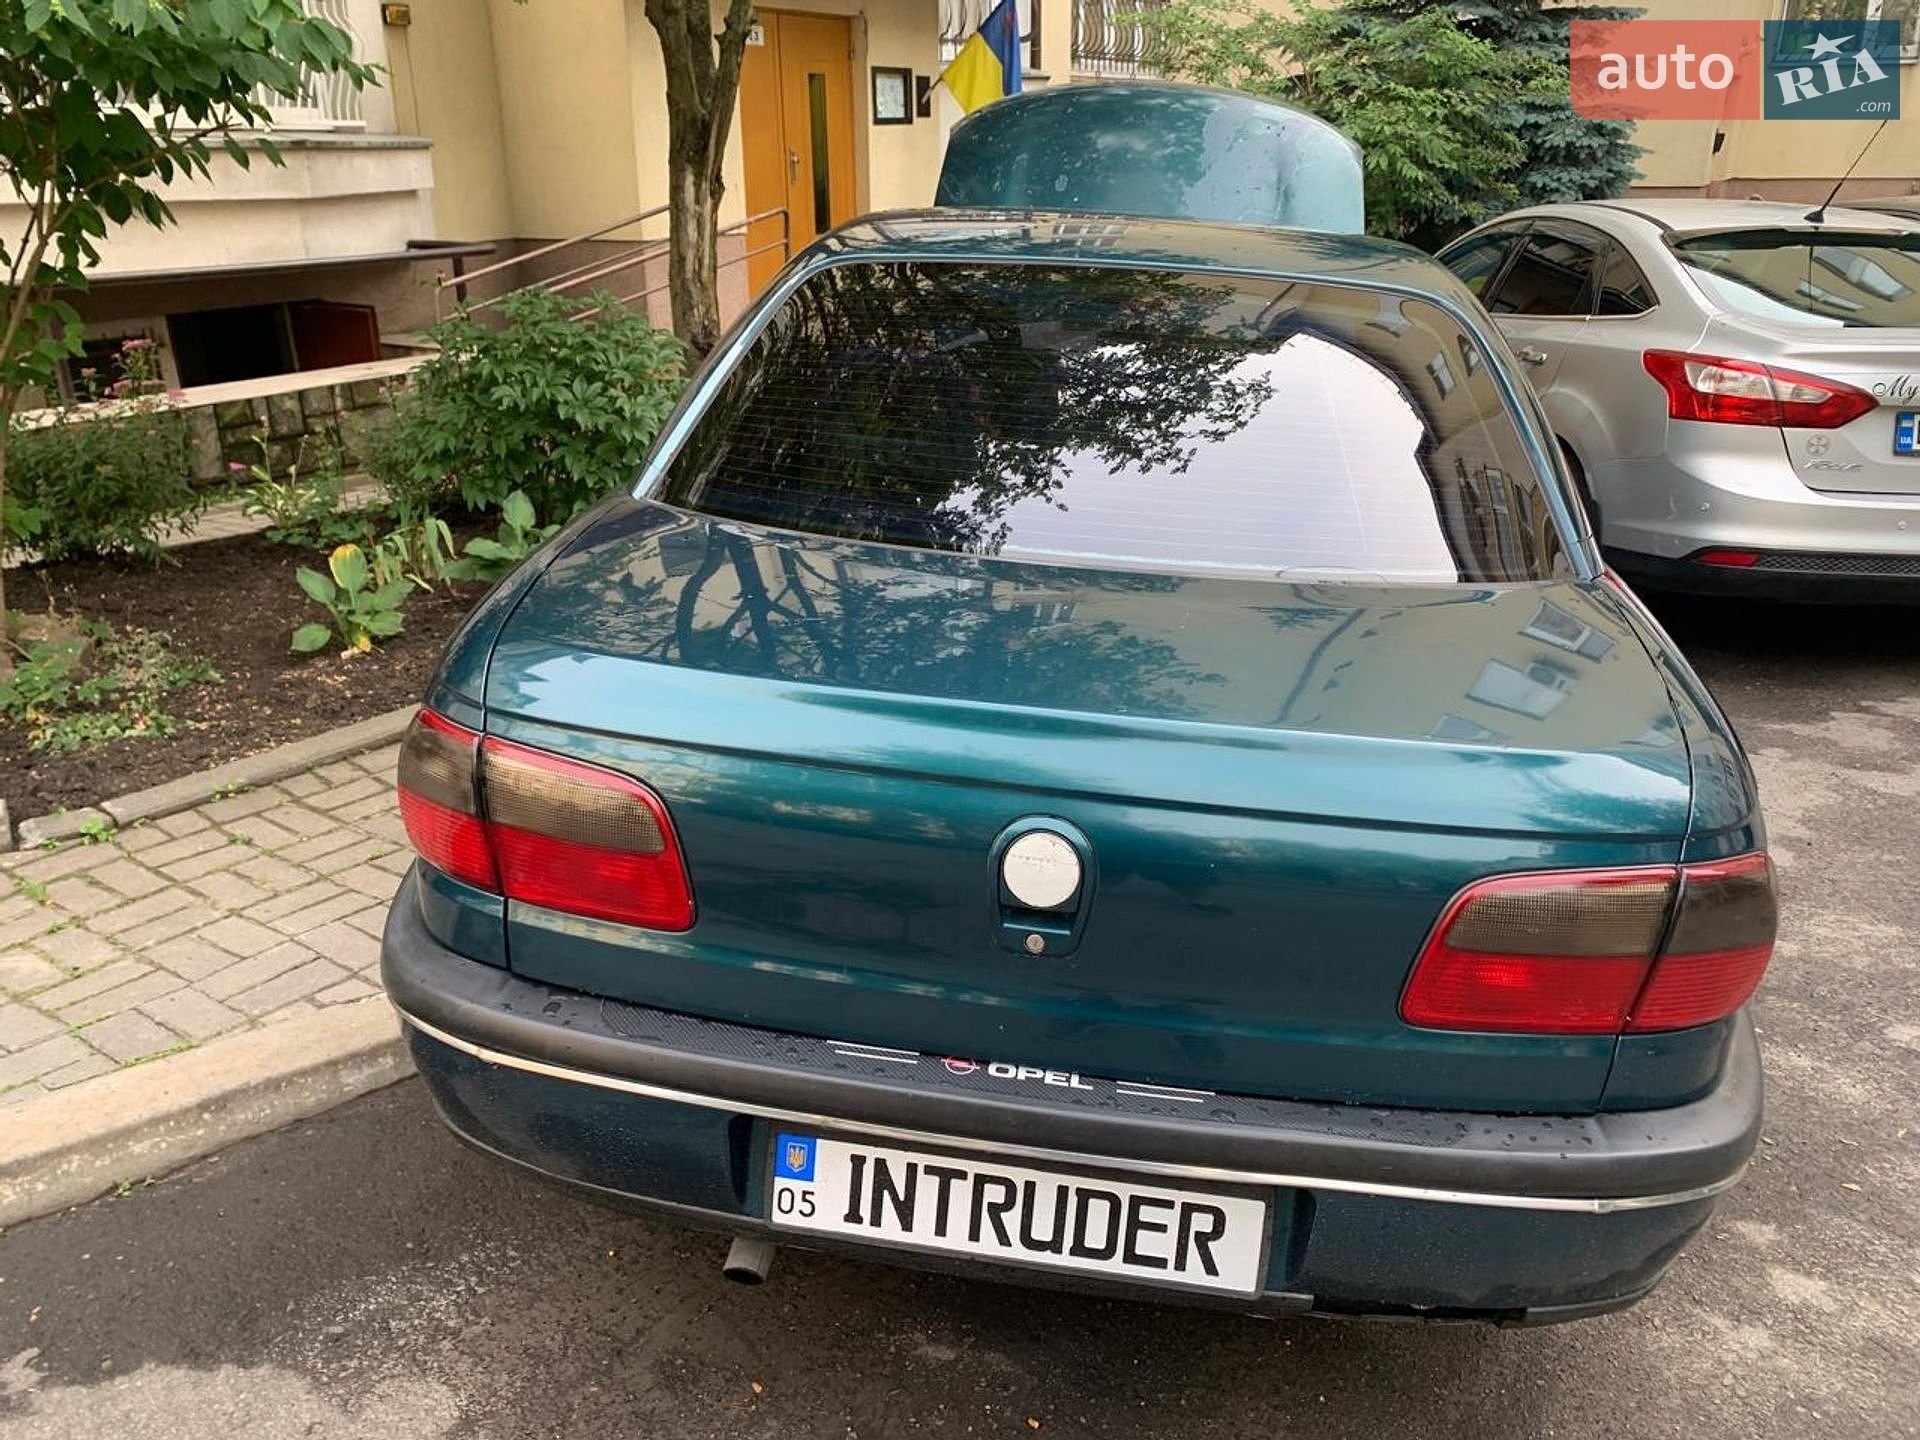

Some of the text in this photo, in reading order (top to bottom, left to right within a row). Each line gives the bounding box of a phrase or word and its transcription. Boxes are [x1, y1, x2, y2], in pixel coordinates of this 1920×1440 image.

[1872, 375, 1919, 405] My
[1900, 436, 1912, 444] UA
[988, 1062, 1093, 1090] OPEL
[777, 1153, 1227, 1277] 05 INTRUDER
